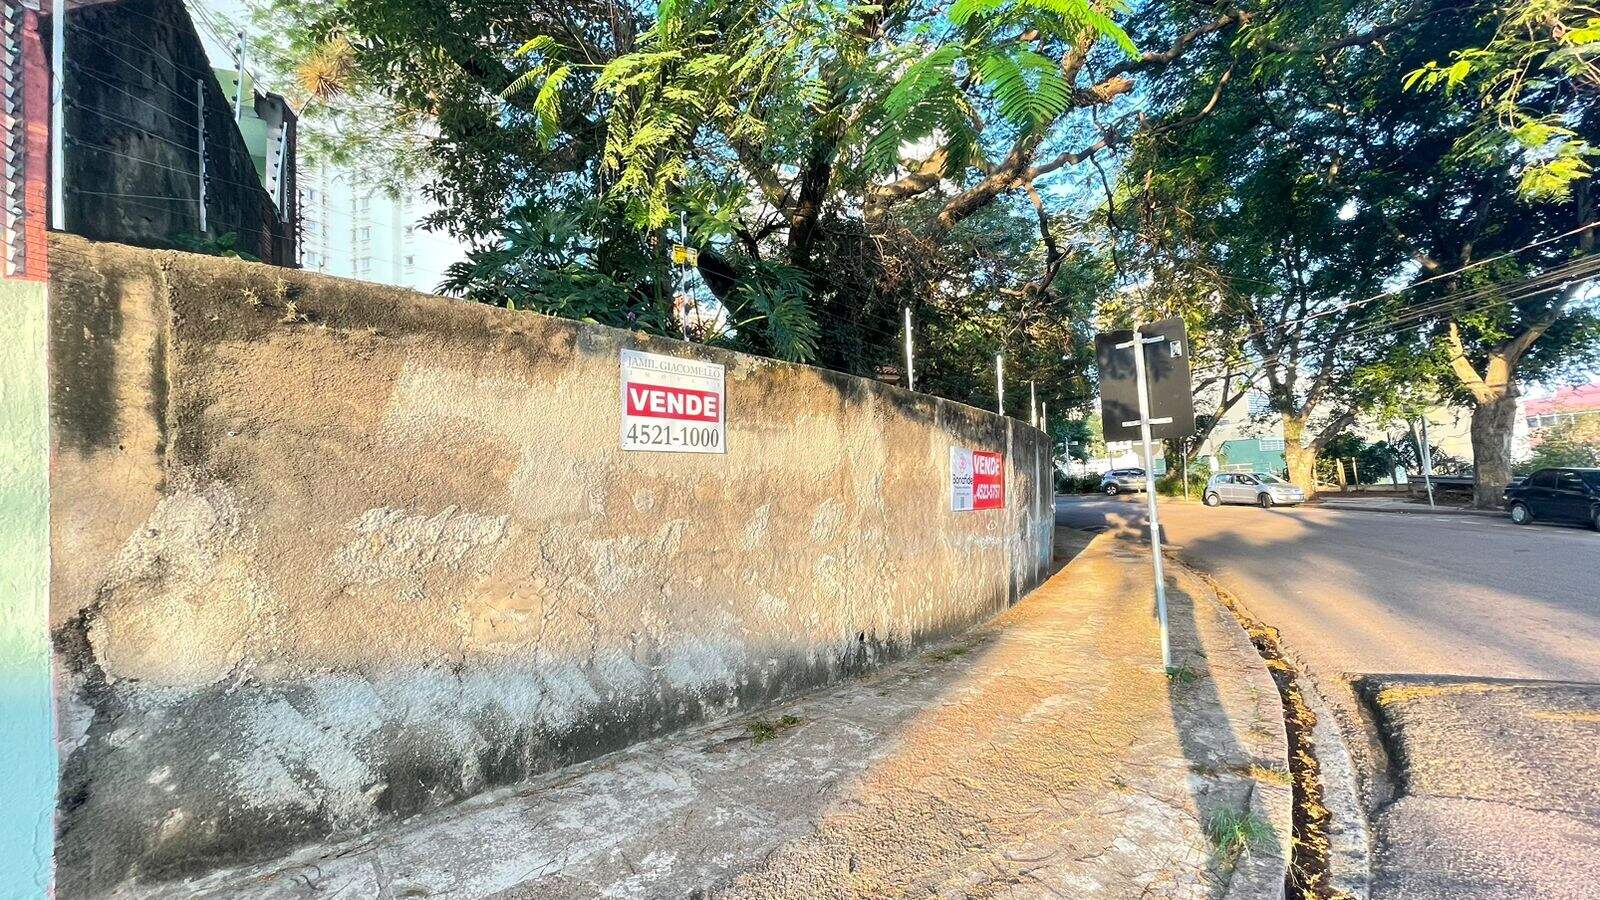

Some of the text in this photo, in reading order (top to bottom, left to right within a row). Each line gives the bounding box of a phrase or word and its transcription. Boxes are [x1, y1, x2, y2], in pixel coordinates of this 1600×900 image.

[627, 355, 720, 378] JAMIL GIACOMELLO
[629, 388, 717, 417] VENDE
[627, 423, 719, 448] 4521-1000
[974, 455, 1000, 476] VENDE
